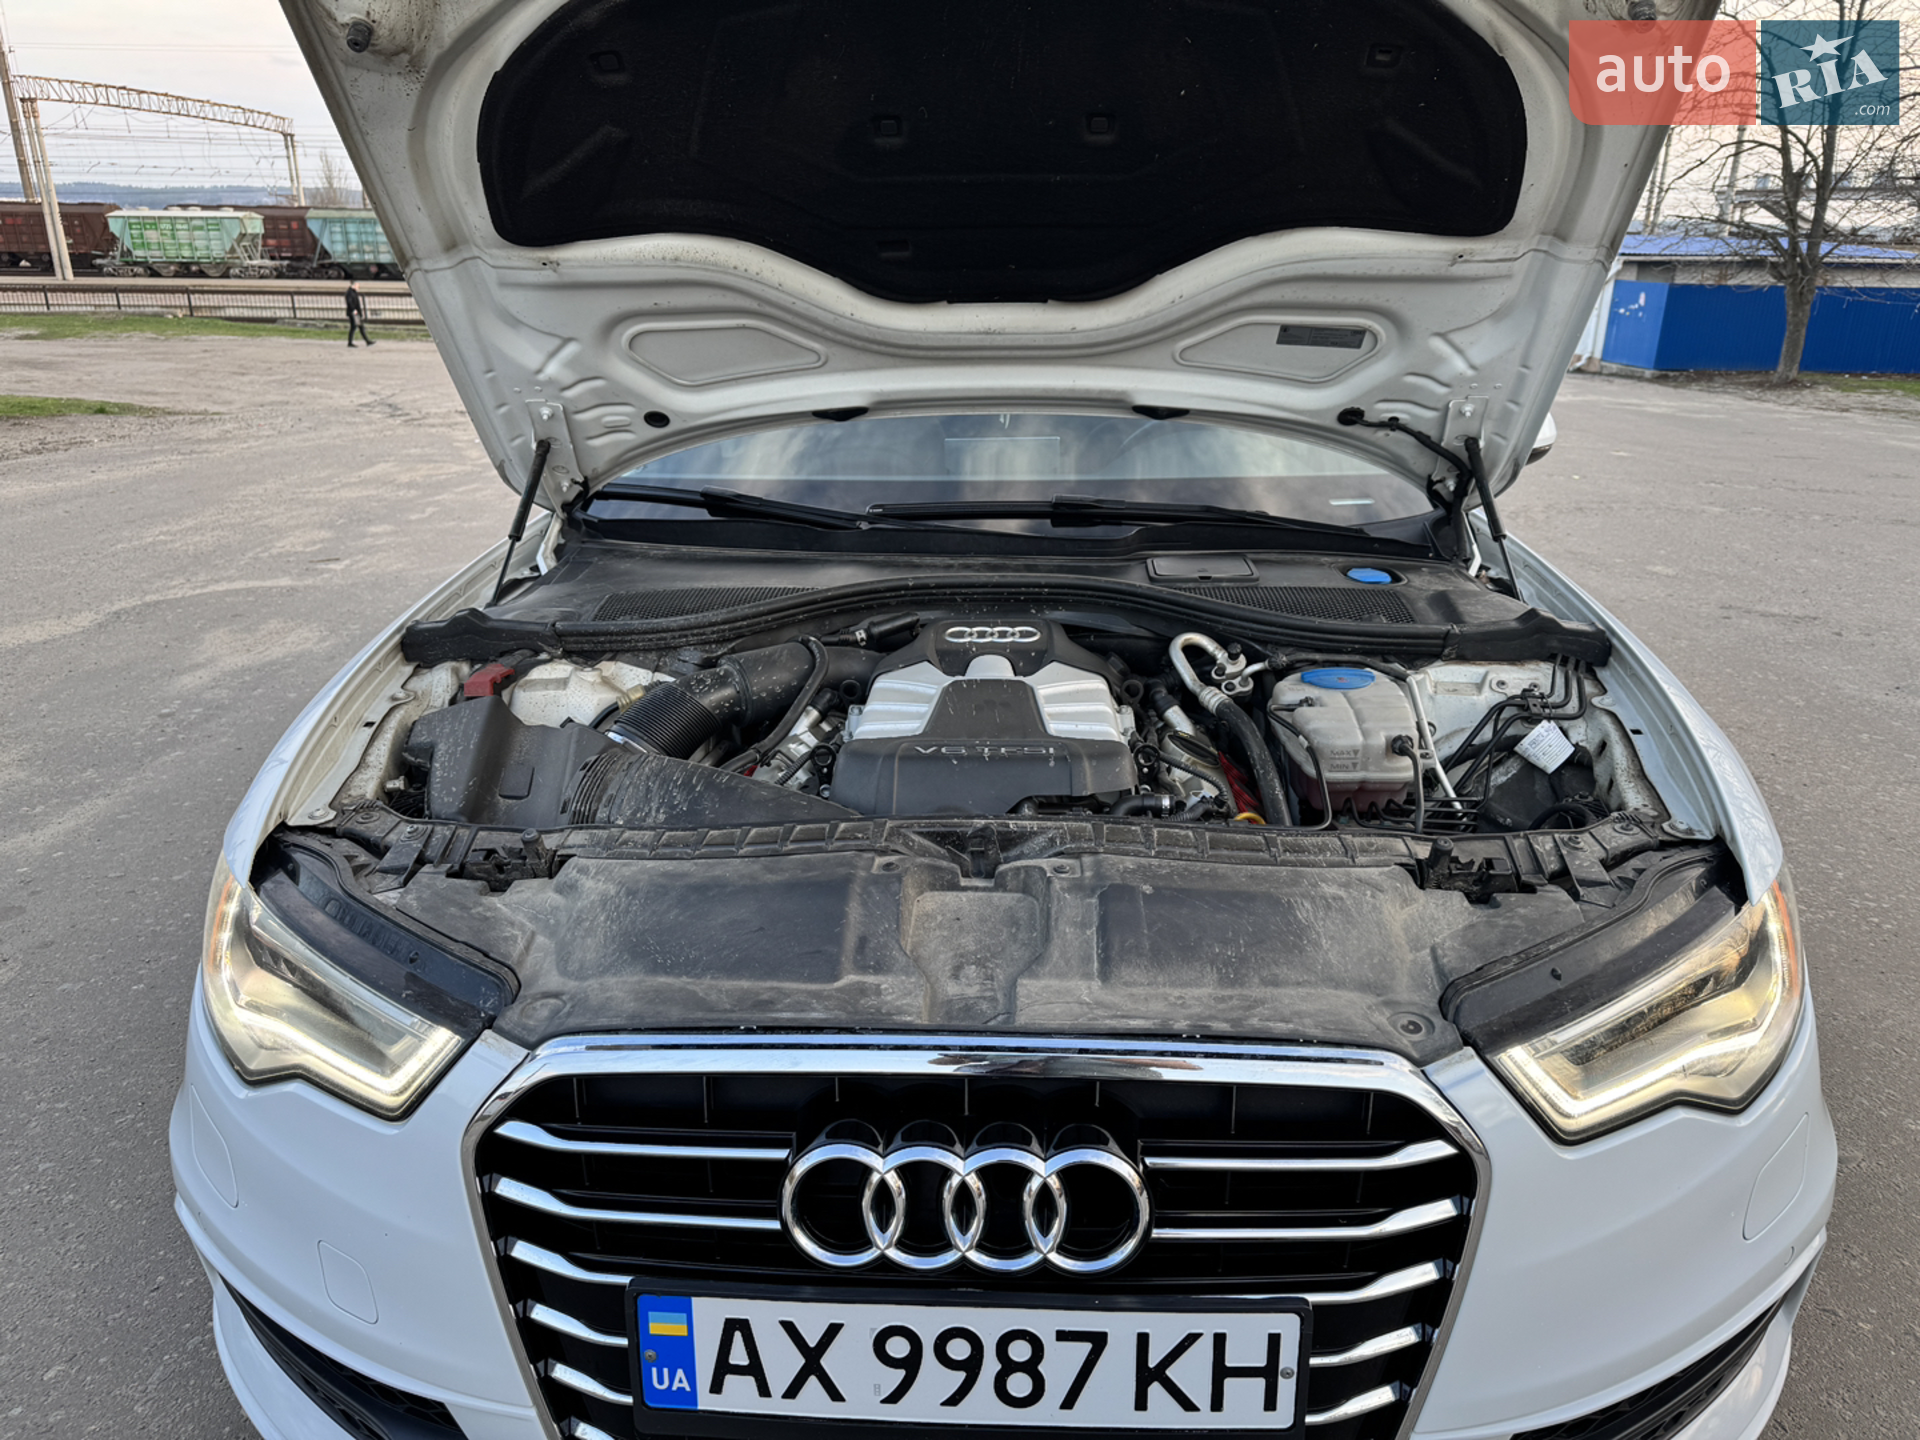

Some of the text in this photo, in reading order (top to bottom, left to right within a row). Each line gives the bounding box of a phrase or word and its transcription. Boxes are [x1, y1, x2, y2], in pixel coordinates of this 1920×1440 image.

[1330, 749, 1352, 757] MAX
[1330, 762, 1350, 770] MIN
[708, 1317, 1282, 1413] AX 9987 KH
[651, 1366, 691, 1392] UA
